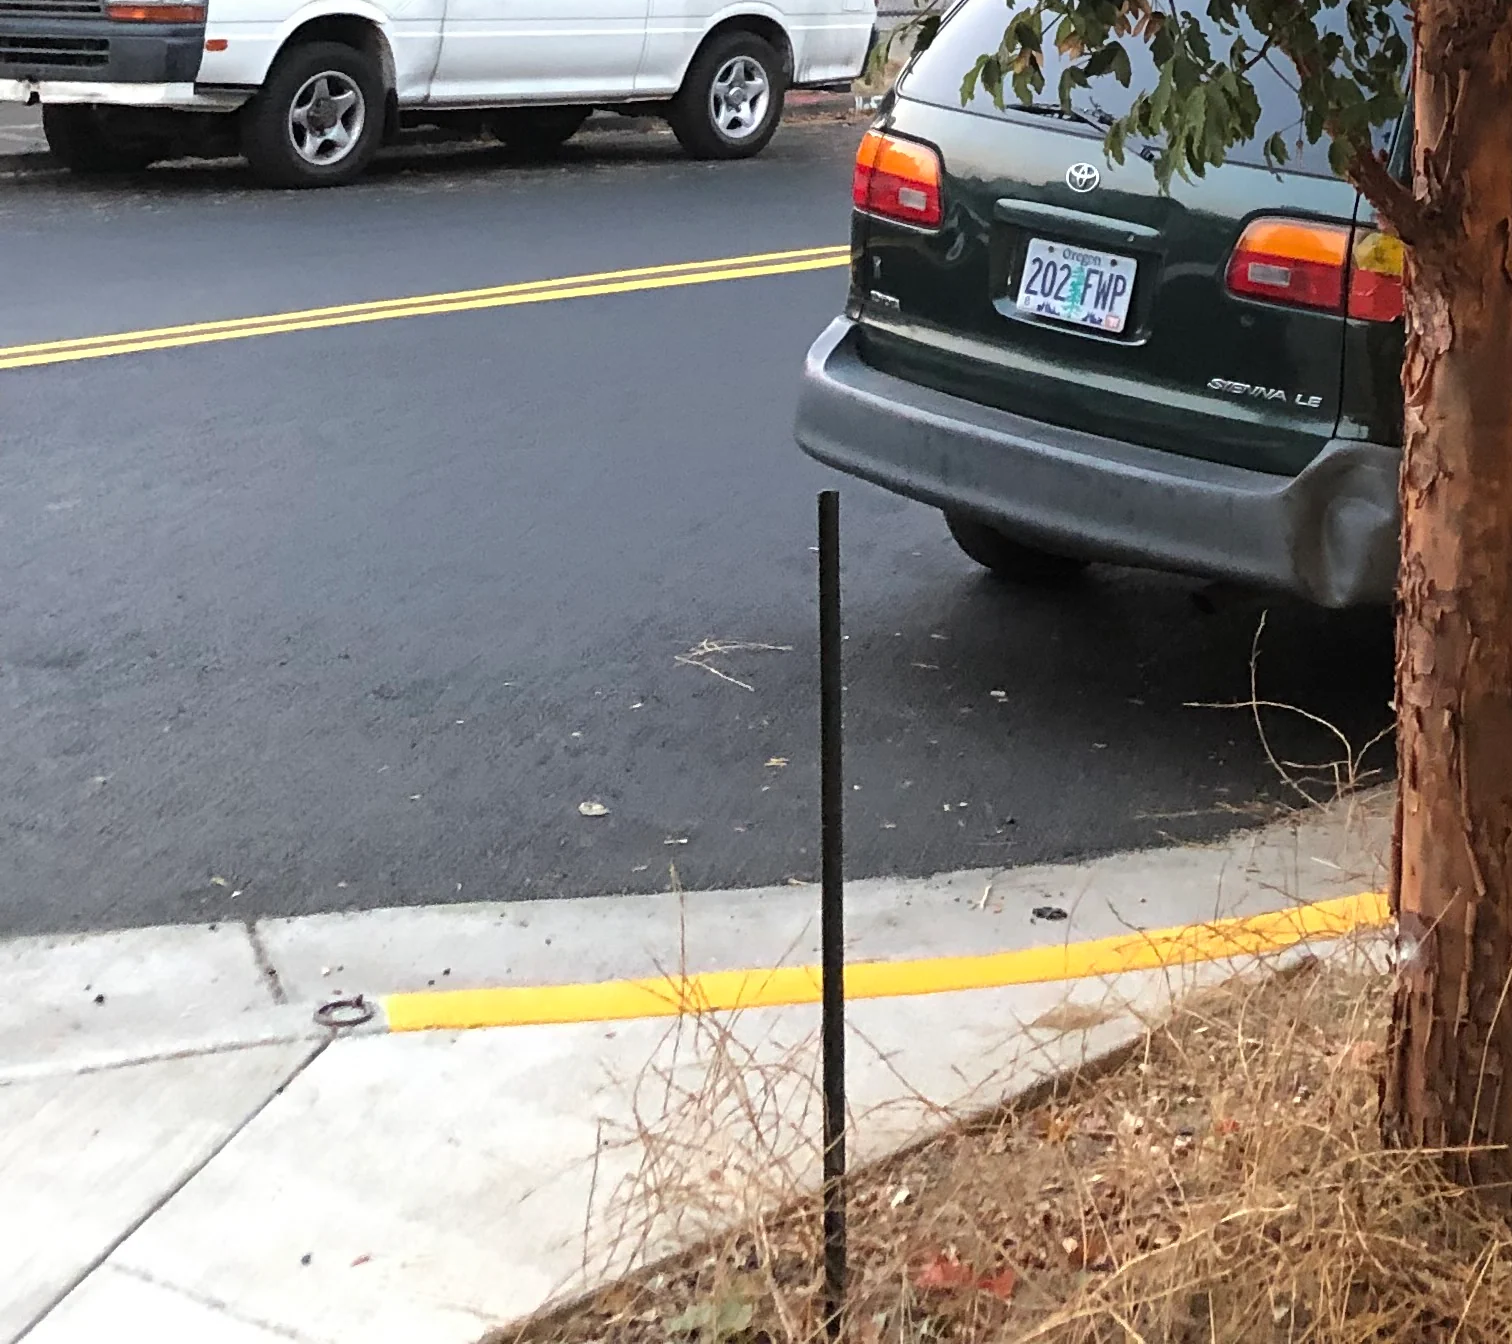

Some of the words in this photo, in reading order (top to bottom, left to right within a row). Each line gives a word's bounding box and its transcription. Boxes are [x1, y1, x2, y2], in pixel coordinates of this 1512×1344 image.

[1062, 248, 1101, 267] Oregon
[1024, 257, 1072, 302] 202
[1080, 267, 1127, 313] FWP
[1207, 378, 1287, 403] SIENNA
[1295, 393, 1323, 408] LE
